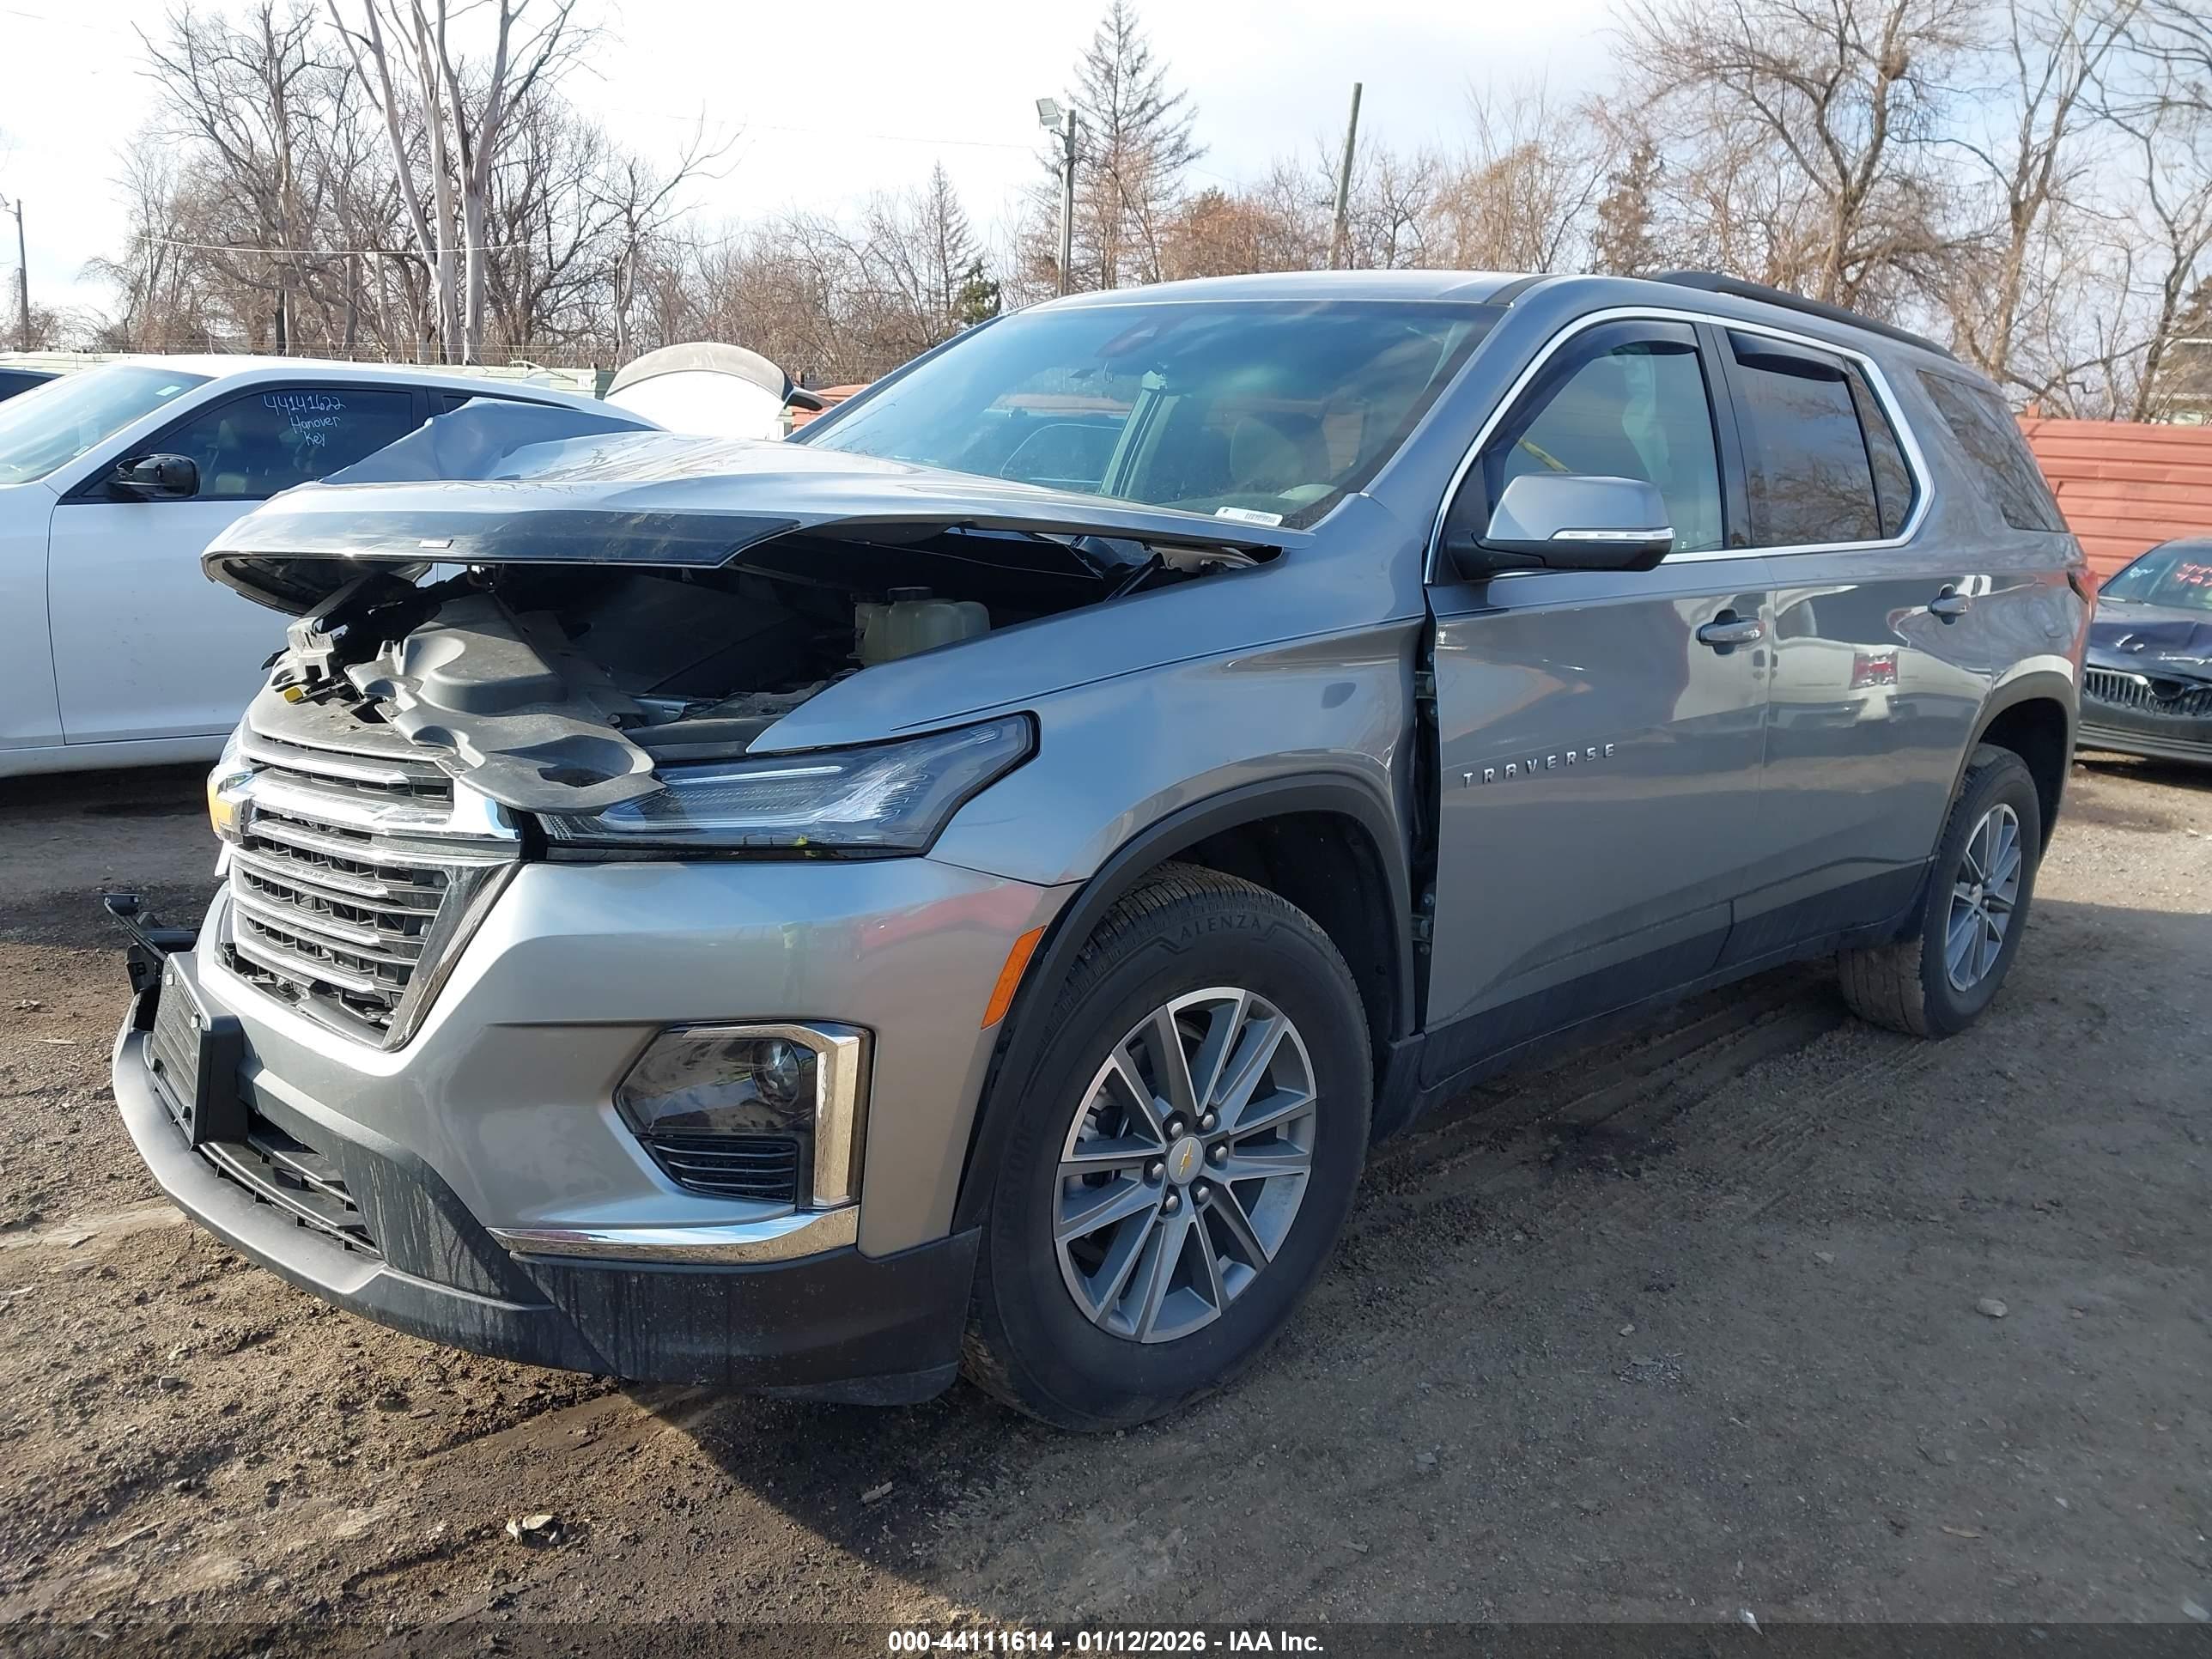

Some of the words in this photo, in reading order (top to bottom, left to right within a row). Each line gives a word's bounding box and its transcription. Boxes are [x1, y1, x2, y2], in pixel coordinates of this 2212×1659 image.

[263, 393, 347, 416] 44141622
[290, 414, 341, 434] Hanover
[303, 430, 325, 447] Key
[1462, 743, 1615, 788] TRAVERSE
[1180, 913, 1262, 942] ALENZA
